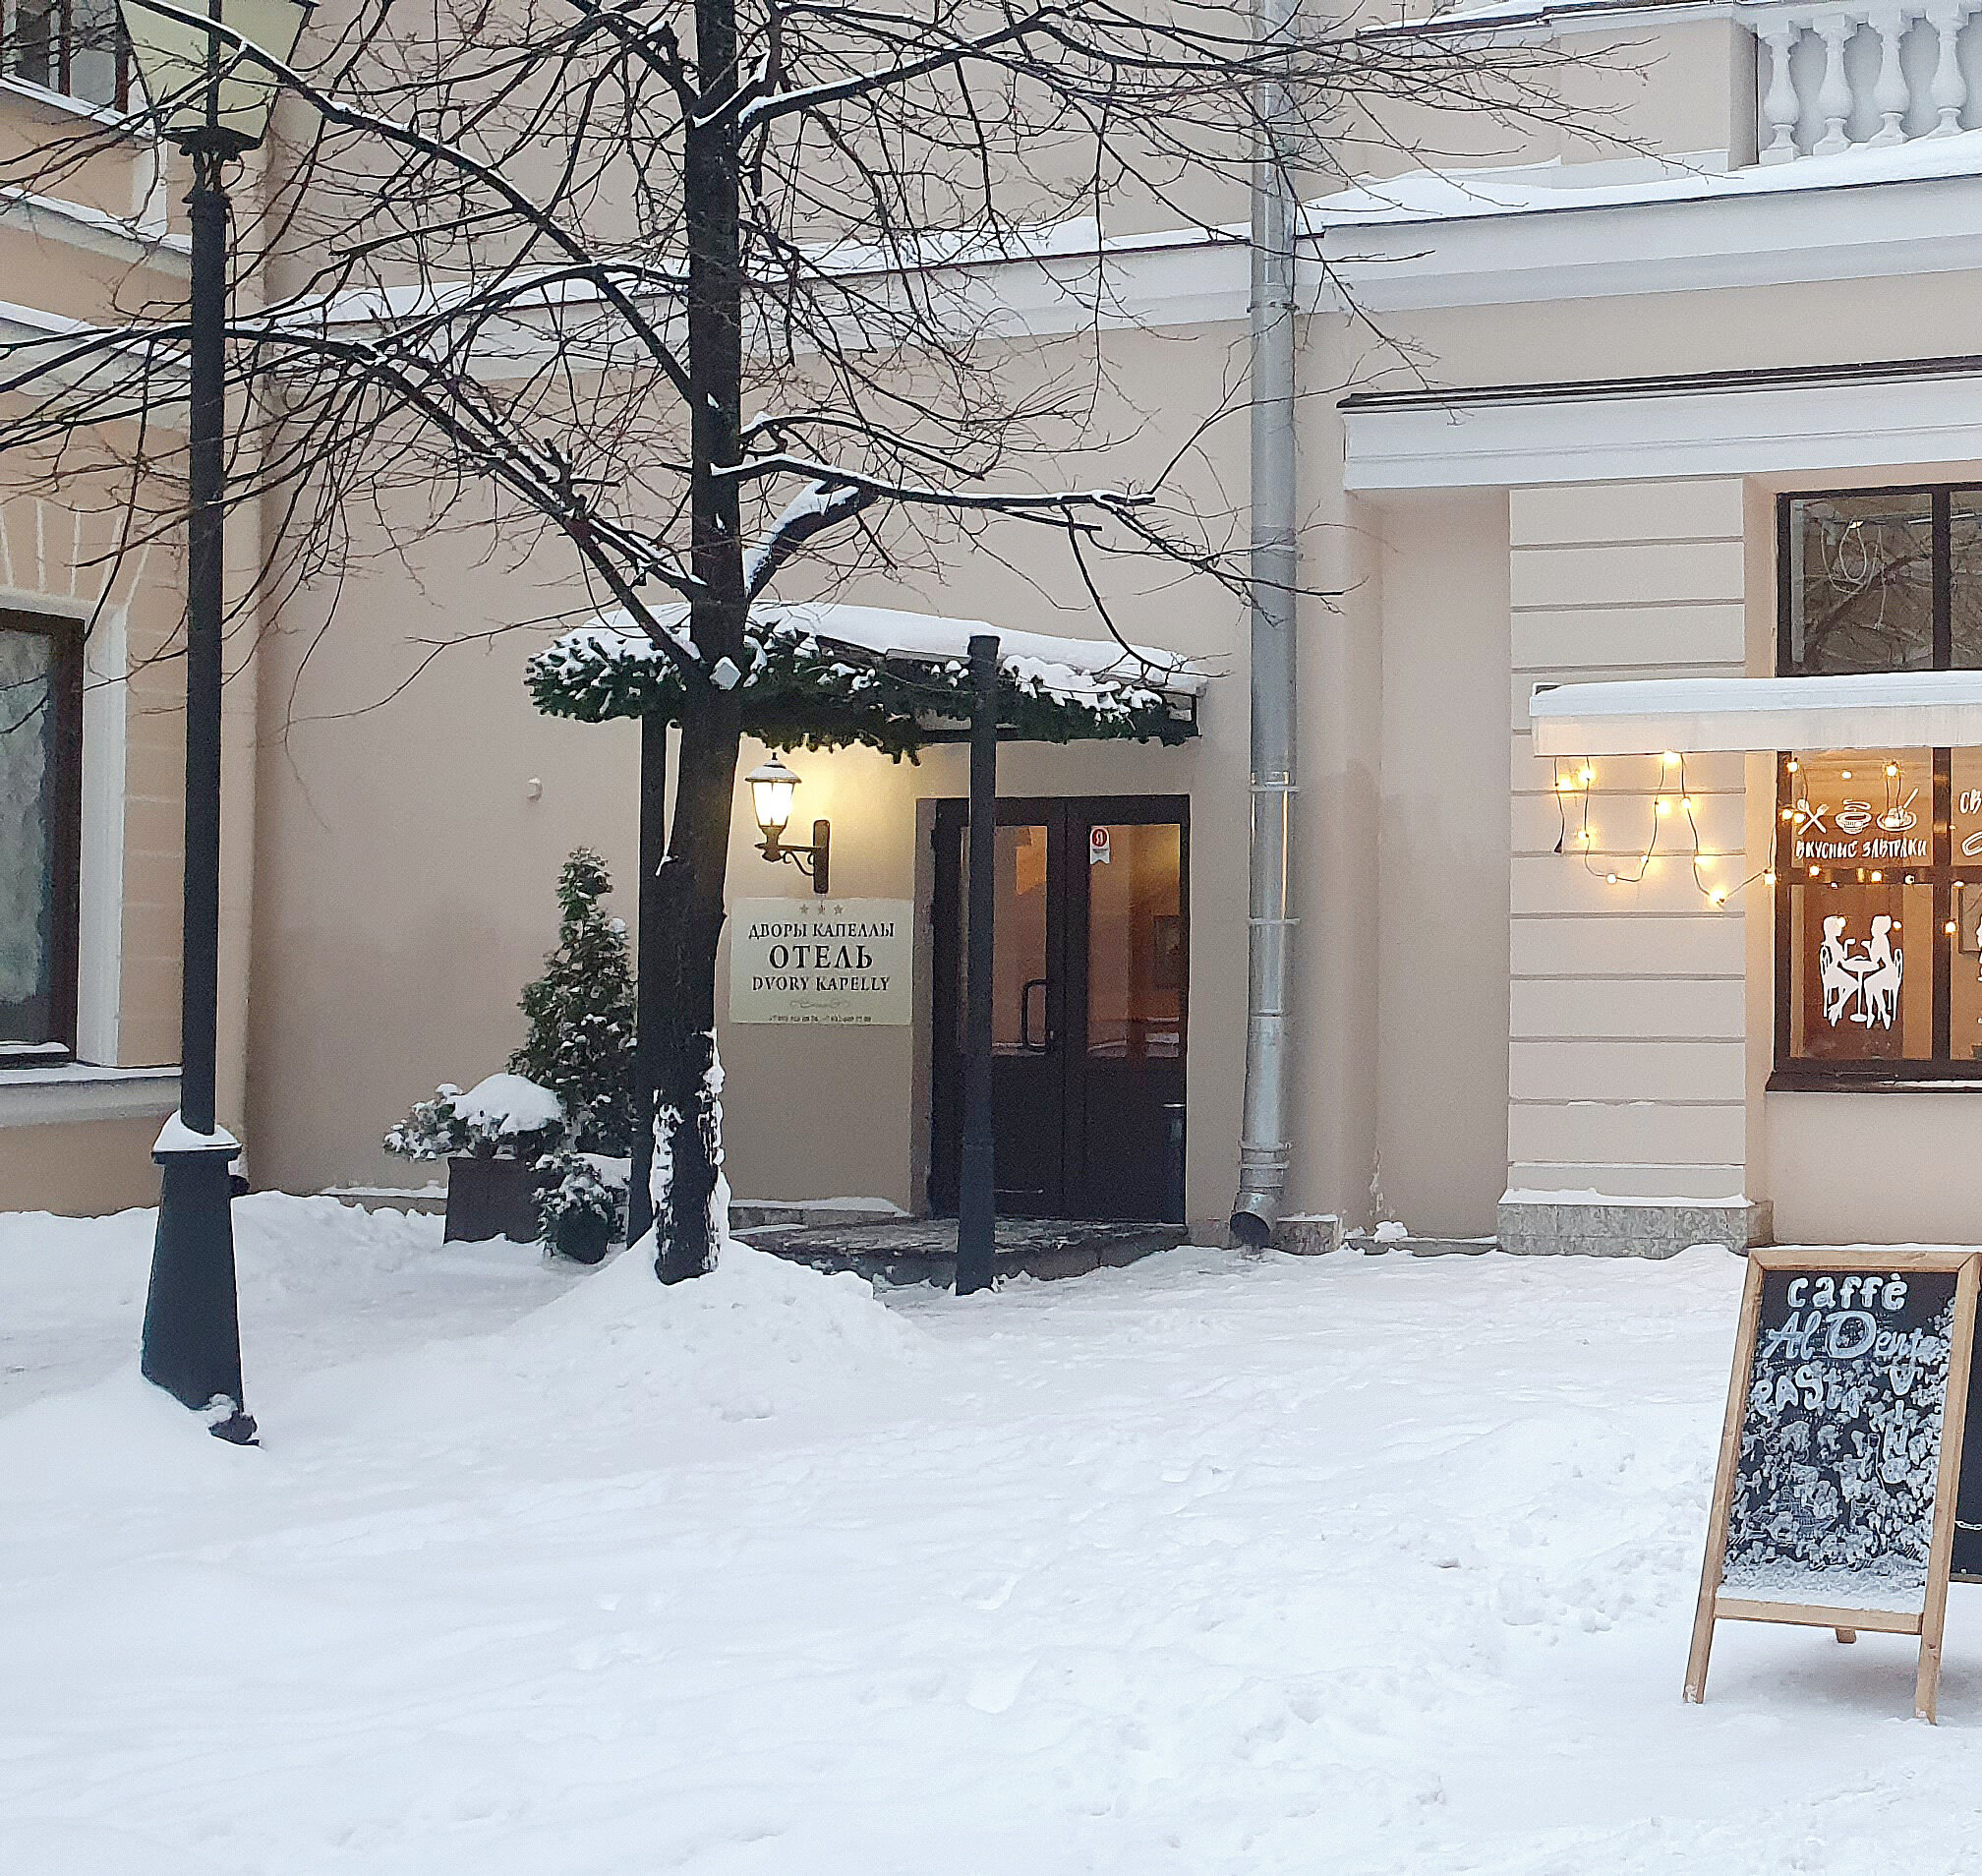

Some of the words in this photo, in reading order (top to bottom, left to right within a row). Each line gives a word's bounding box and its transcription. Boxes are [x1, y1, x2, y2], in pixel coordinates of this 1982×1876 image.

[748, 923, 807, 940] ДВОРЫ
[813, 922, 894, 937] КАПЕЛЛЫ
[769, 944, 873, 968] ОТЕЛЬ
[752, 976, 809, 991] DVORY
[816, 976, 890, 991] KAPELLY
[1763, 1311, 1822, 1360] Al
